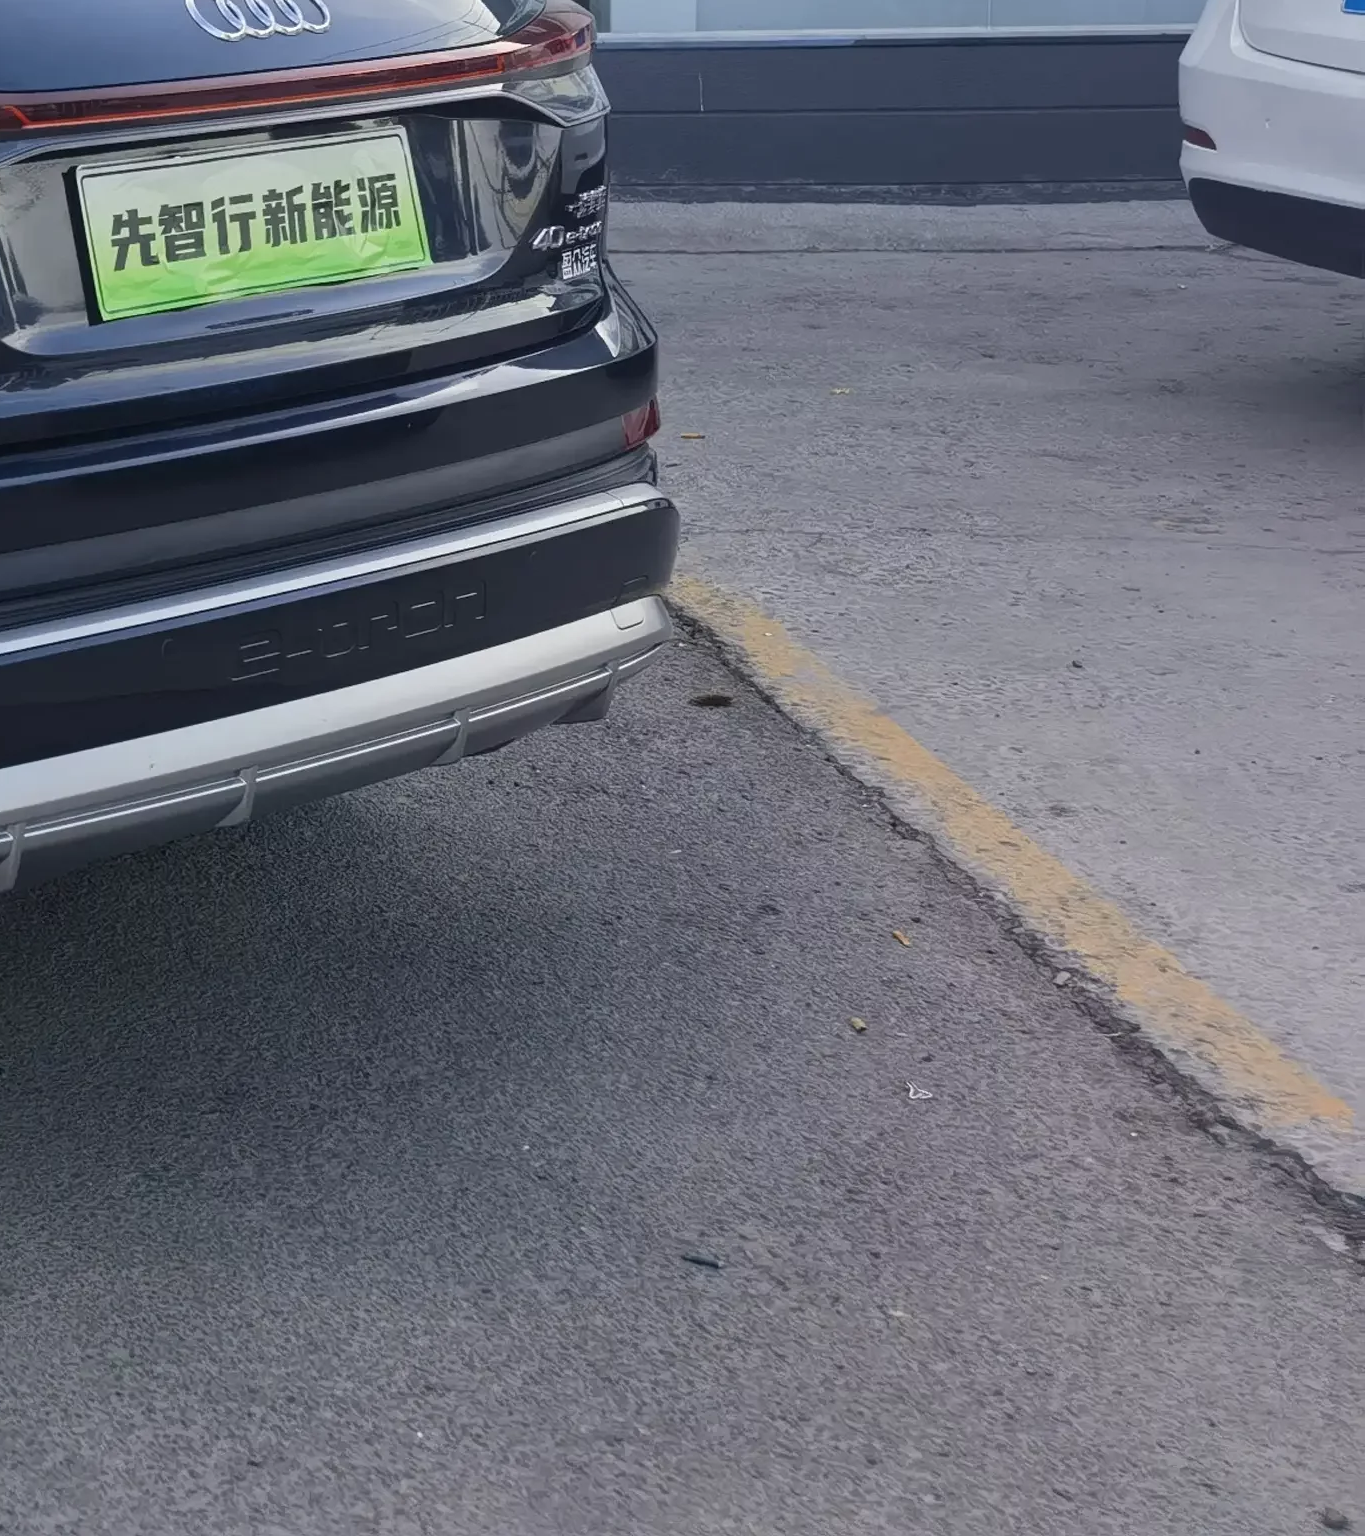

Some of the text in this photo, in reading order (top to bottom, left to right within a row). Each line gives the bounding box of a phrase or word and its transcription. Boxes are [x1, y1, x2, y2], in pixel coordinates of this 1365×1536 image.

[110, 172, 402, 273] 先智行新能源
[532, 225, 565, 252] 40
